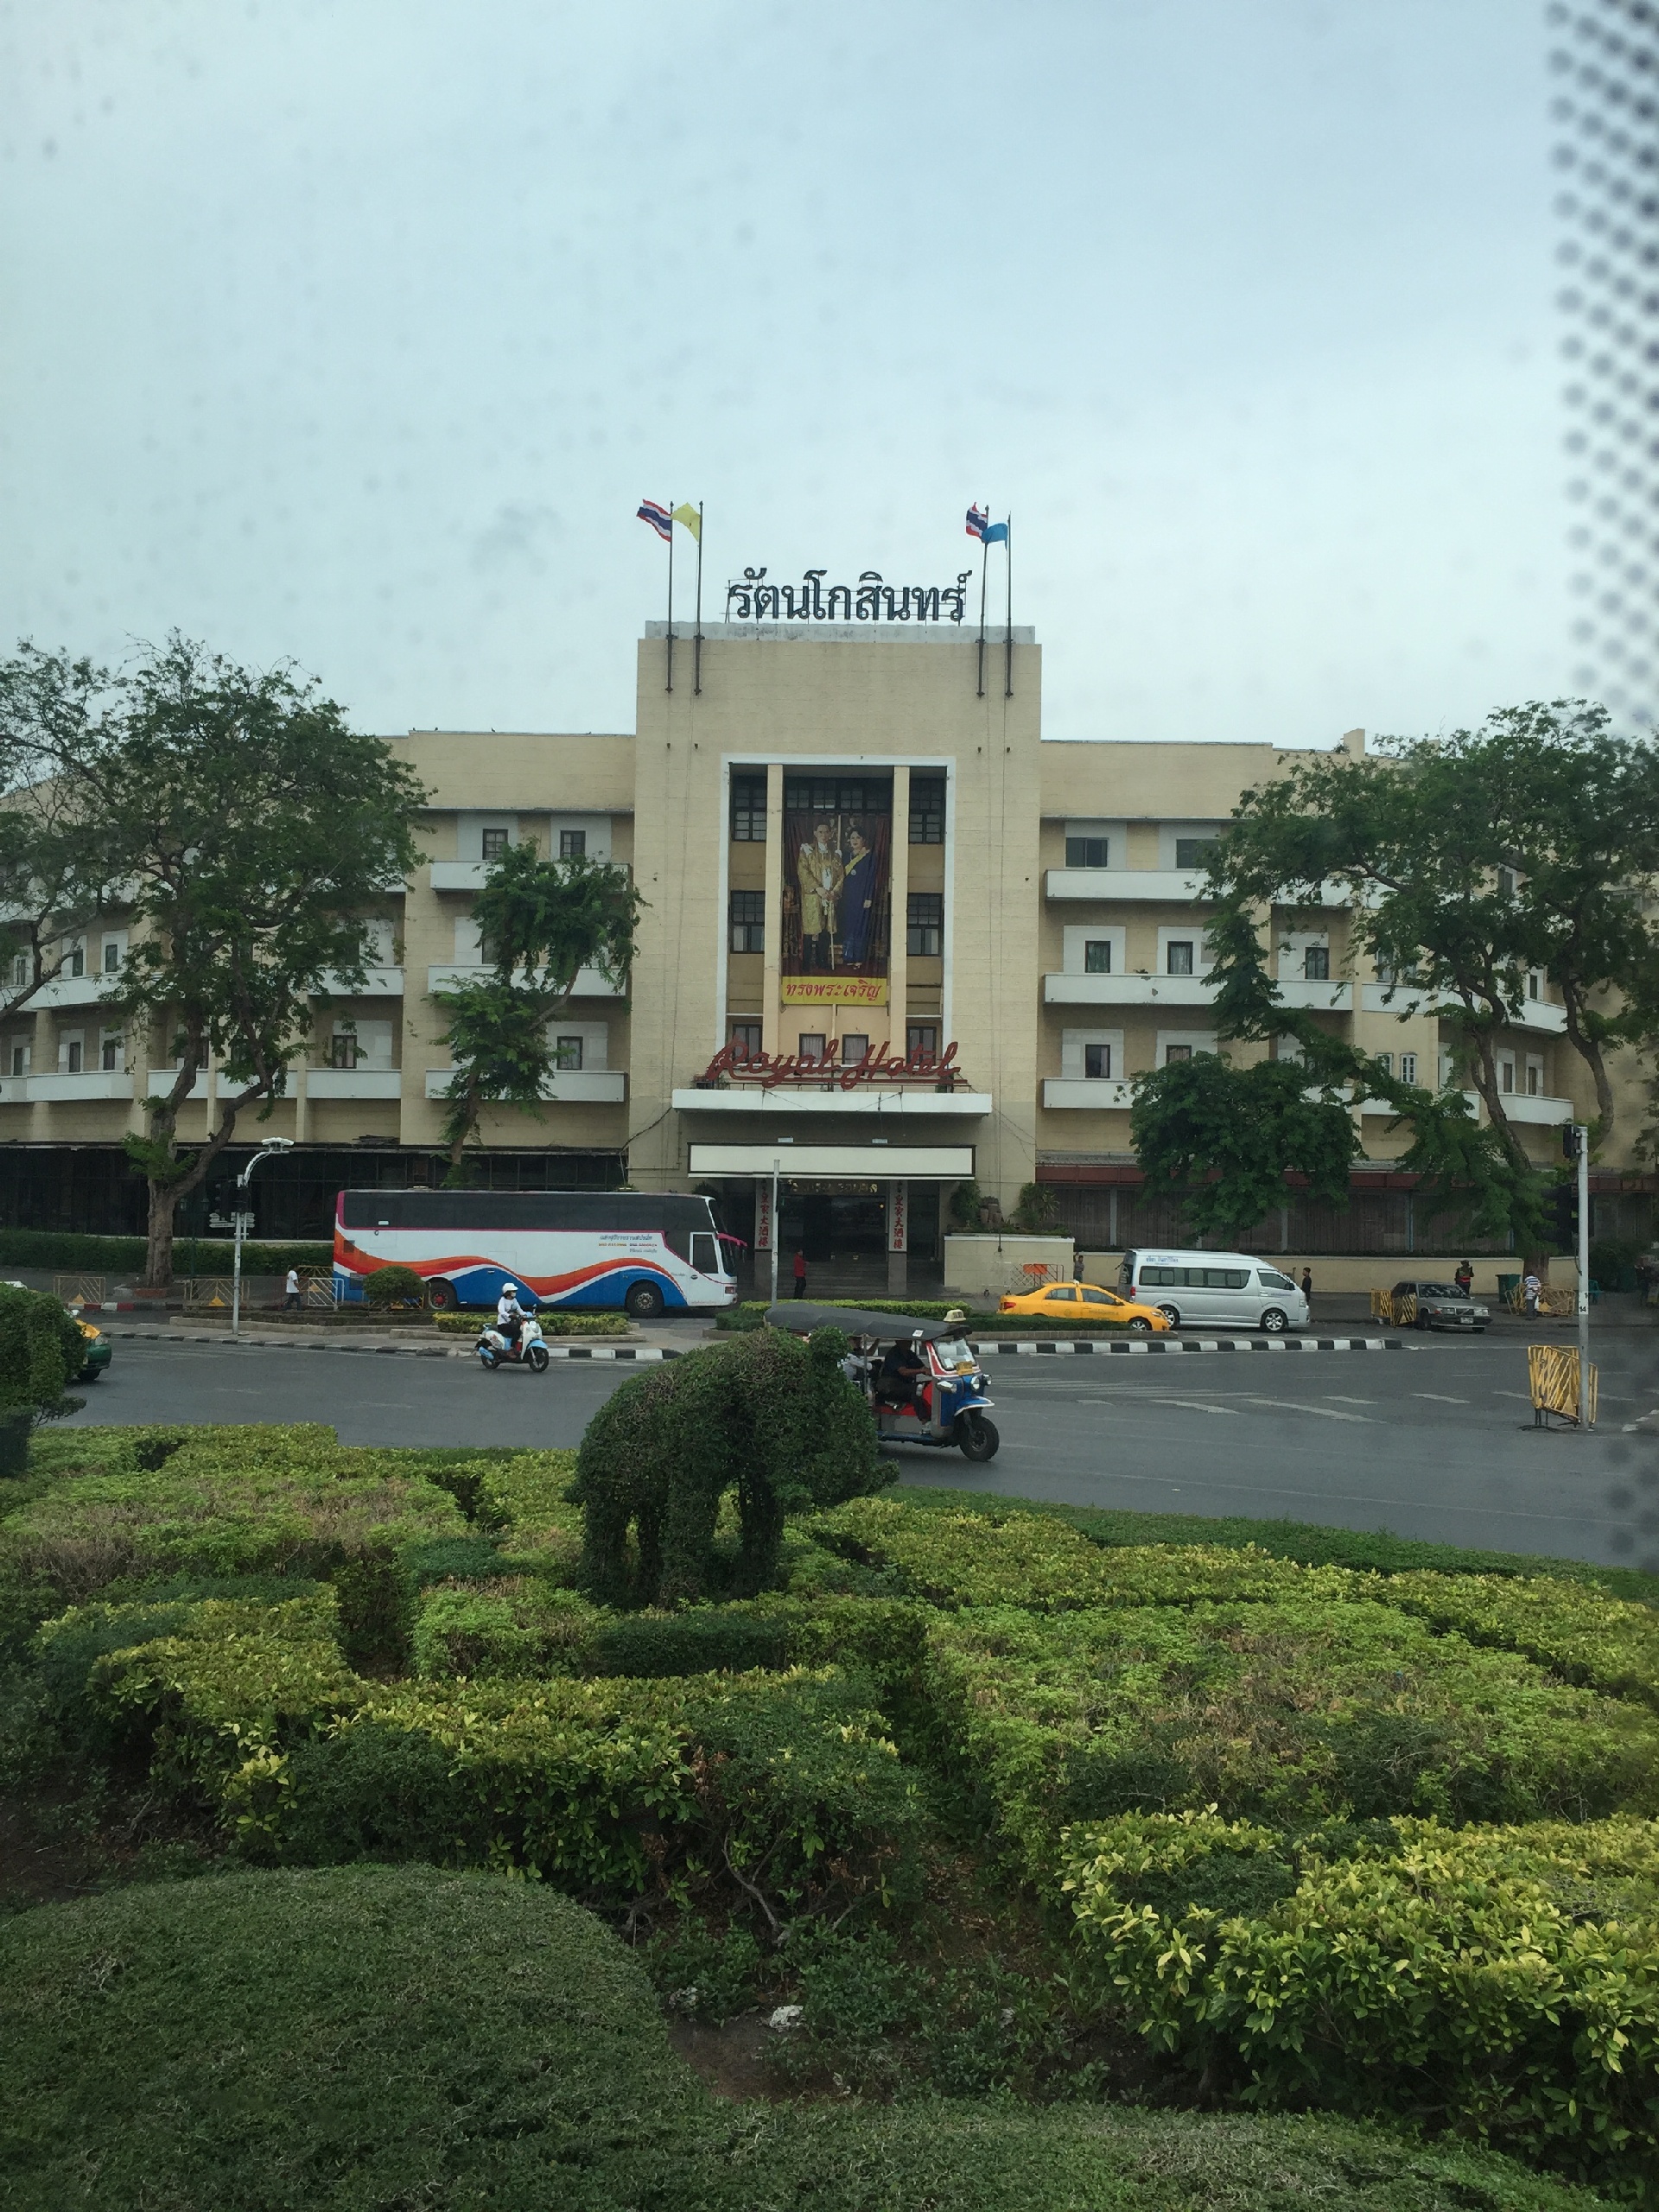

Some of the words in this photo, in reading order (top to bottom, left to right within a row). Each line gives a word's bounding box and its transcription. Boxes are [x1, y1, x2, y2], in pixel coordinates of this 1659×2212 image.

[728, 567, 973, 622] รัตนโกสินทร์
[785, 977, 882, 1001] ทรงพระเจริญ
[705, 1038, 841, 1089] Royal
[841, 1040, 961, 1090] Hotel
